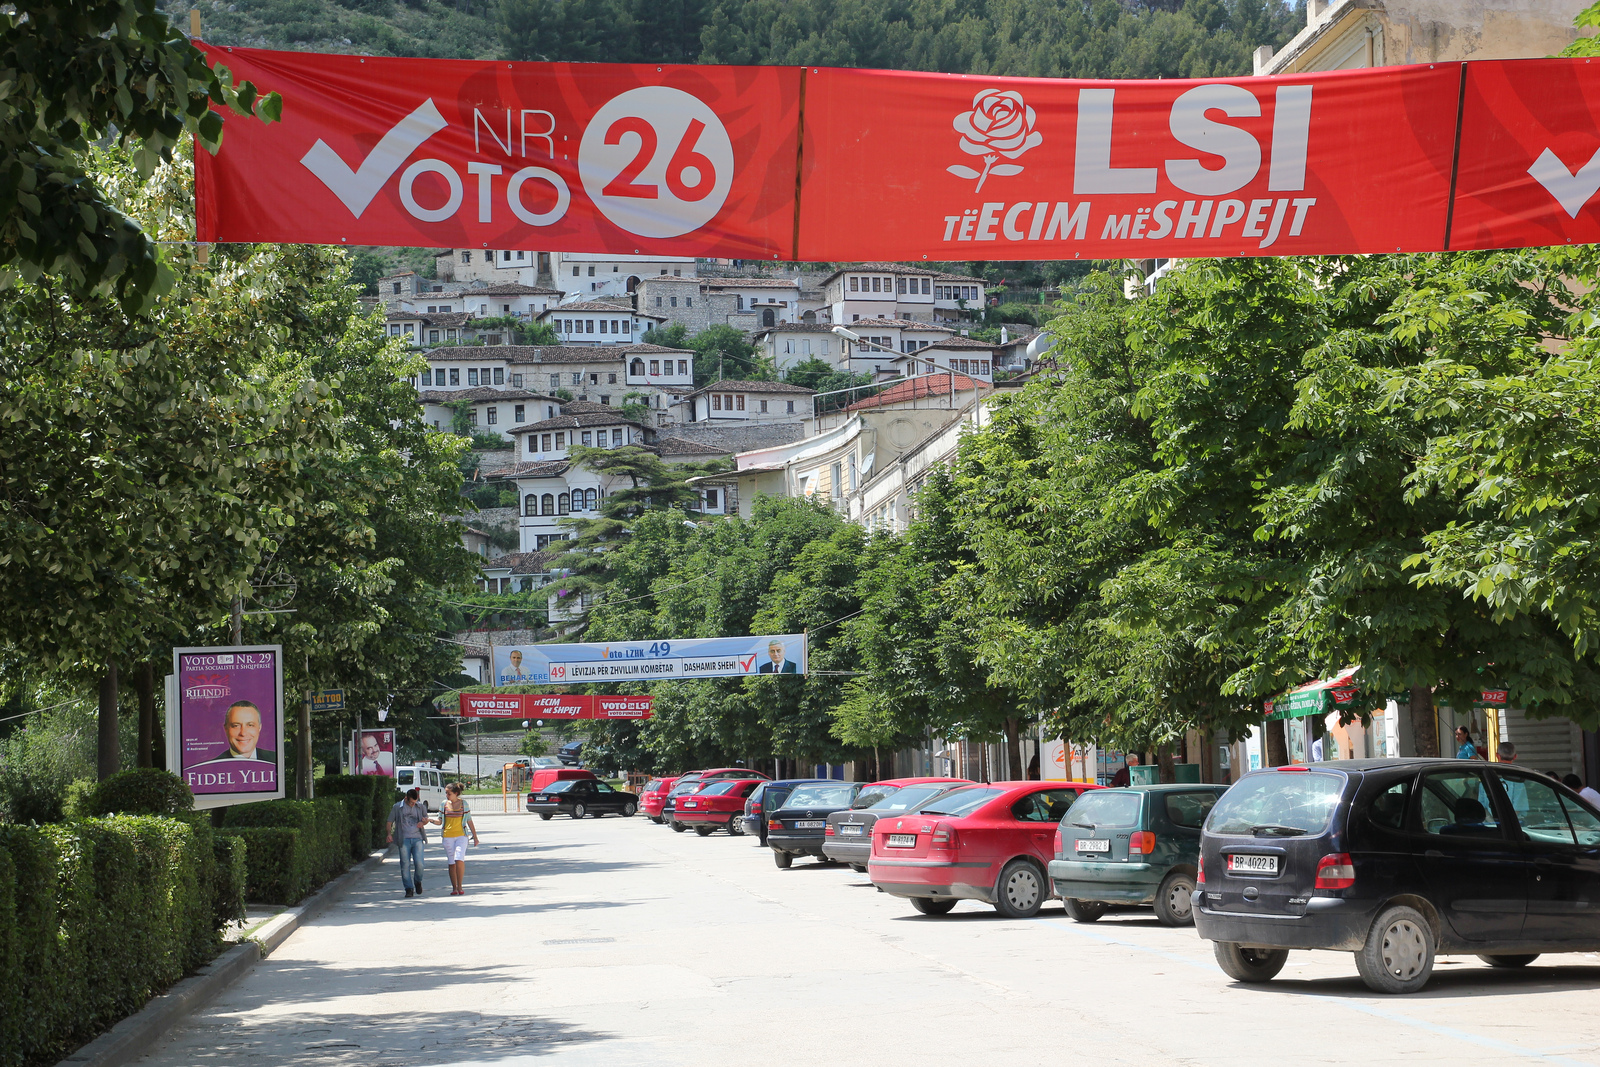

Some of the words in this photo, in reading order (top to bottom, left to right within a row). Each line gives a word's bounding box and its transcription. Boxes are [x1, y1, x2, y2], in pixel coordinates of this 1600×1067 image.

[1073, 83, 1313, 196] LSI
[473, 107, 570, 160] NR:
[602, 116, 717, 202] 26
[625, 649, 645, 658] LZHK
[649, 641, 671, 657] 49
[258, 652, 272, 664] 29
[550, 666, 566, 678] 49
[571, 664, 597, 677] LËVIZJA
[597, 663, 609, 676] PËR
[609, 663, 639, 675] ZHVILLIM
[640, 661, 674, 674] KOMBËTAR
[683, 661, 717, 672] DASHAMIR
[717, 660, 736, 670] SHEHI
[500, 674, 526, 682] BEHAR
[528, 673, 548, 681] ZERE
[185, 688, 232, 698] RILINDJE
[312, 693, 342, 704] TATTOO
[470, 700, 495, 709] VOTO
[505, 701, 519, 709] LSI
[602, 702, 627, 710] VOTO
[636, 702, 649, 710] LSI
[552, 706, 582, 716] SHPEJT
[187, 772, 236, 786] FIDEL
[238, 770, 275, 784] YLLI
[1269, 858, 1275, 870] B
